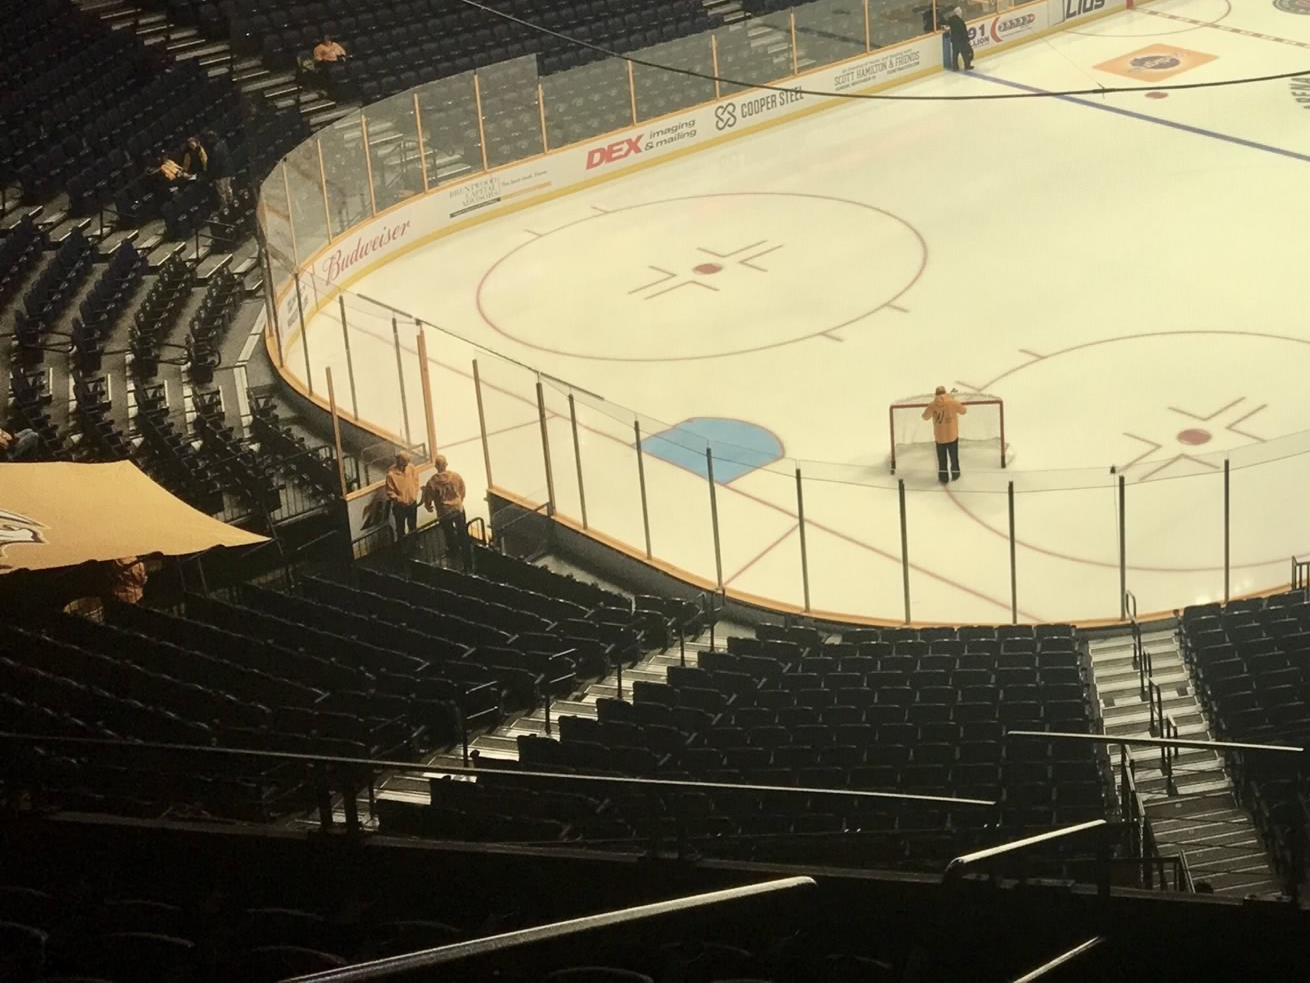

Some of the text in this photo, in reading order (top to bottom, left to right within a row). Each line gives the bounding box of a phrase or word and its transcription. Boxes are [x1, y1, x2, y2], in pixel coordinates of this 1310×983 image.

[834, 70, 856, 87] SCOTT
[857, 61, 887, 79] HAMILTON
[741, 86, 804, 119] COOPER STEEL
[644, 128, 699, 152] & mailing
[649, 119, 697, 140] imaging
[586, 133, 646, 171] DEX
[322, 220, 412, 286] Budweiser
